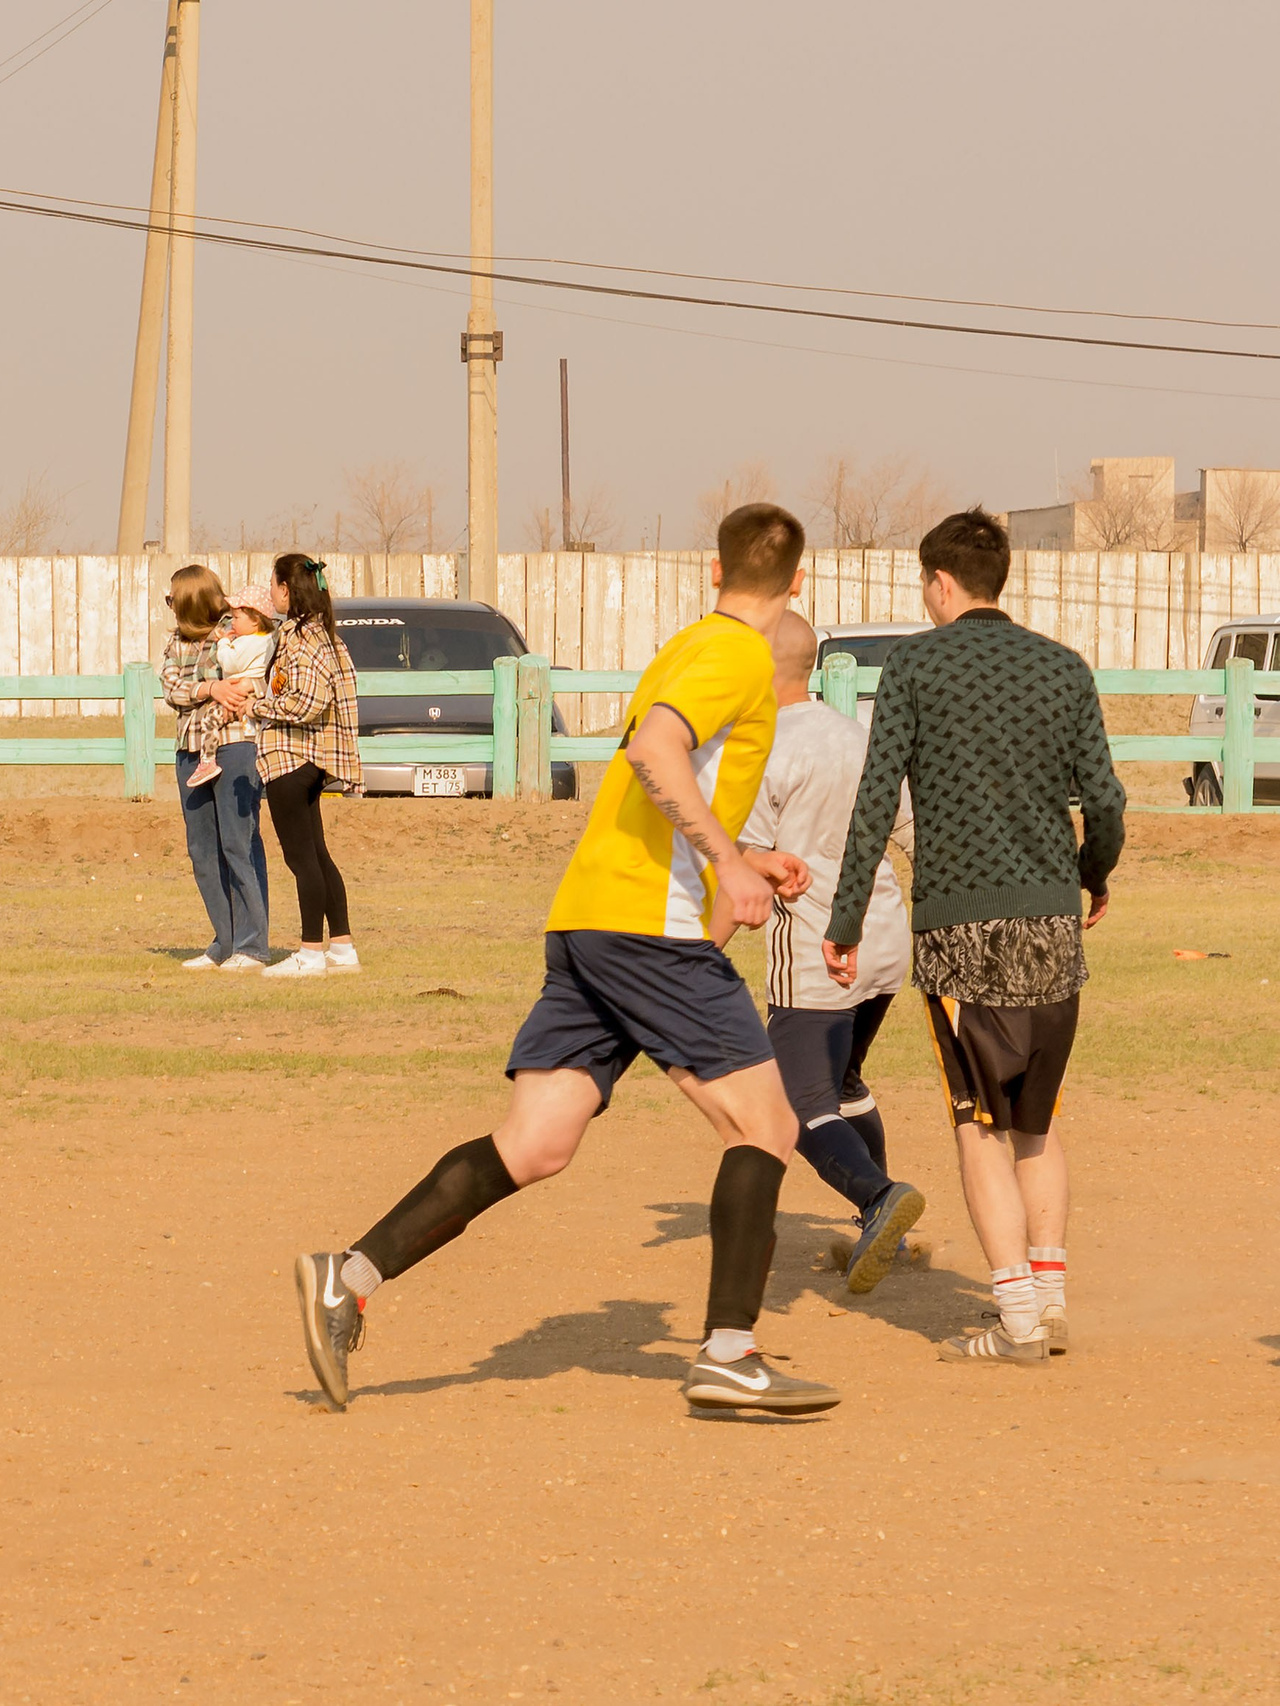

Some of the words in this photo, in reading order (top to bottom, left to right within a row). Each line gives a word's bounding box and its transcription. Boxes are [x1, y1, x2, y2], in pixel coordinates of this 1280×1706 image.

[423, 769, 432, 779] M
[436, 769, 457, 779] 383
[422, 783, 438, 793] ET
[448, 782, 460, 792] 75
